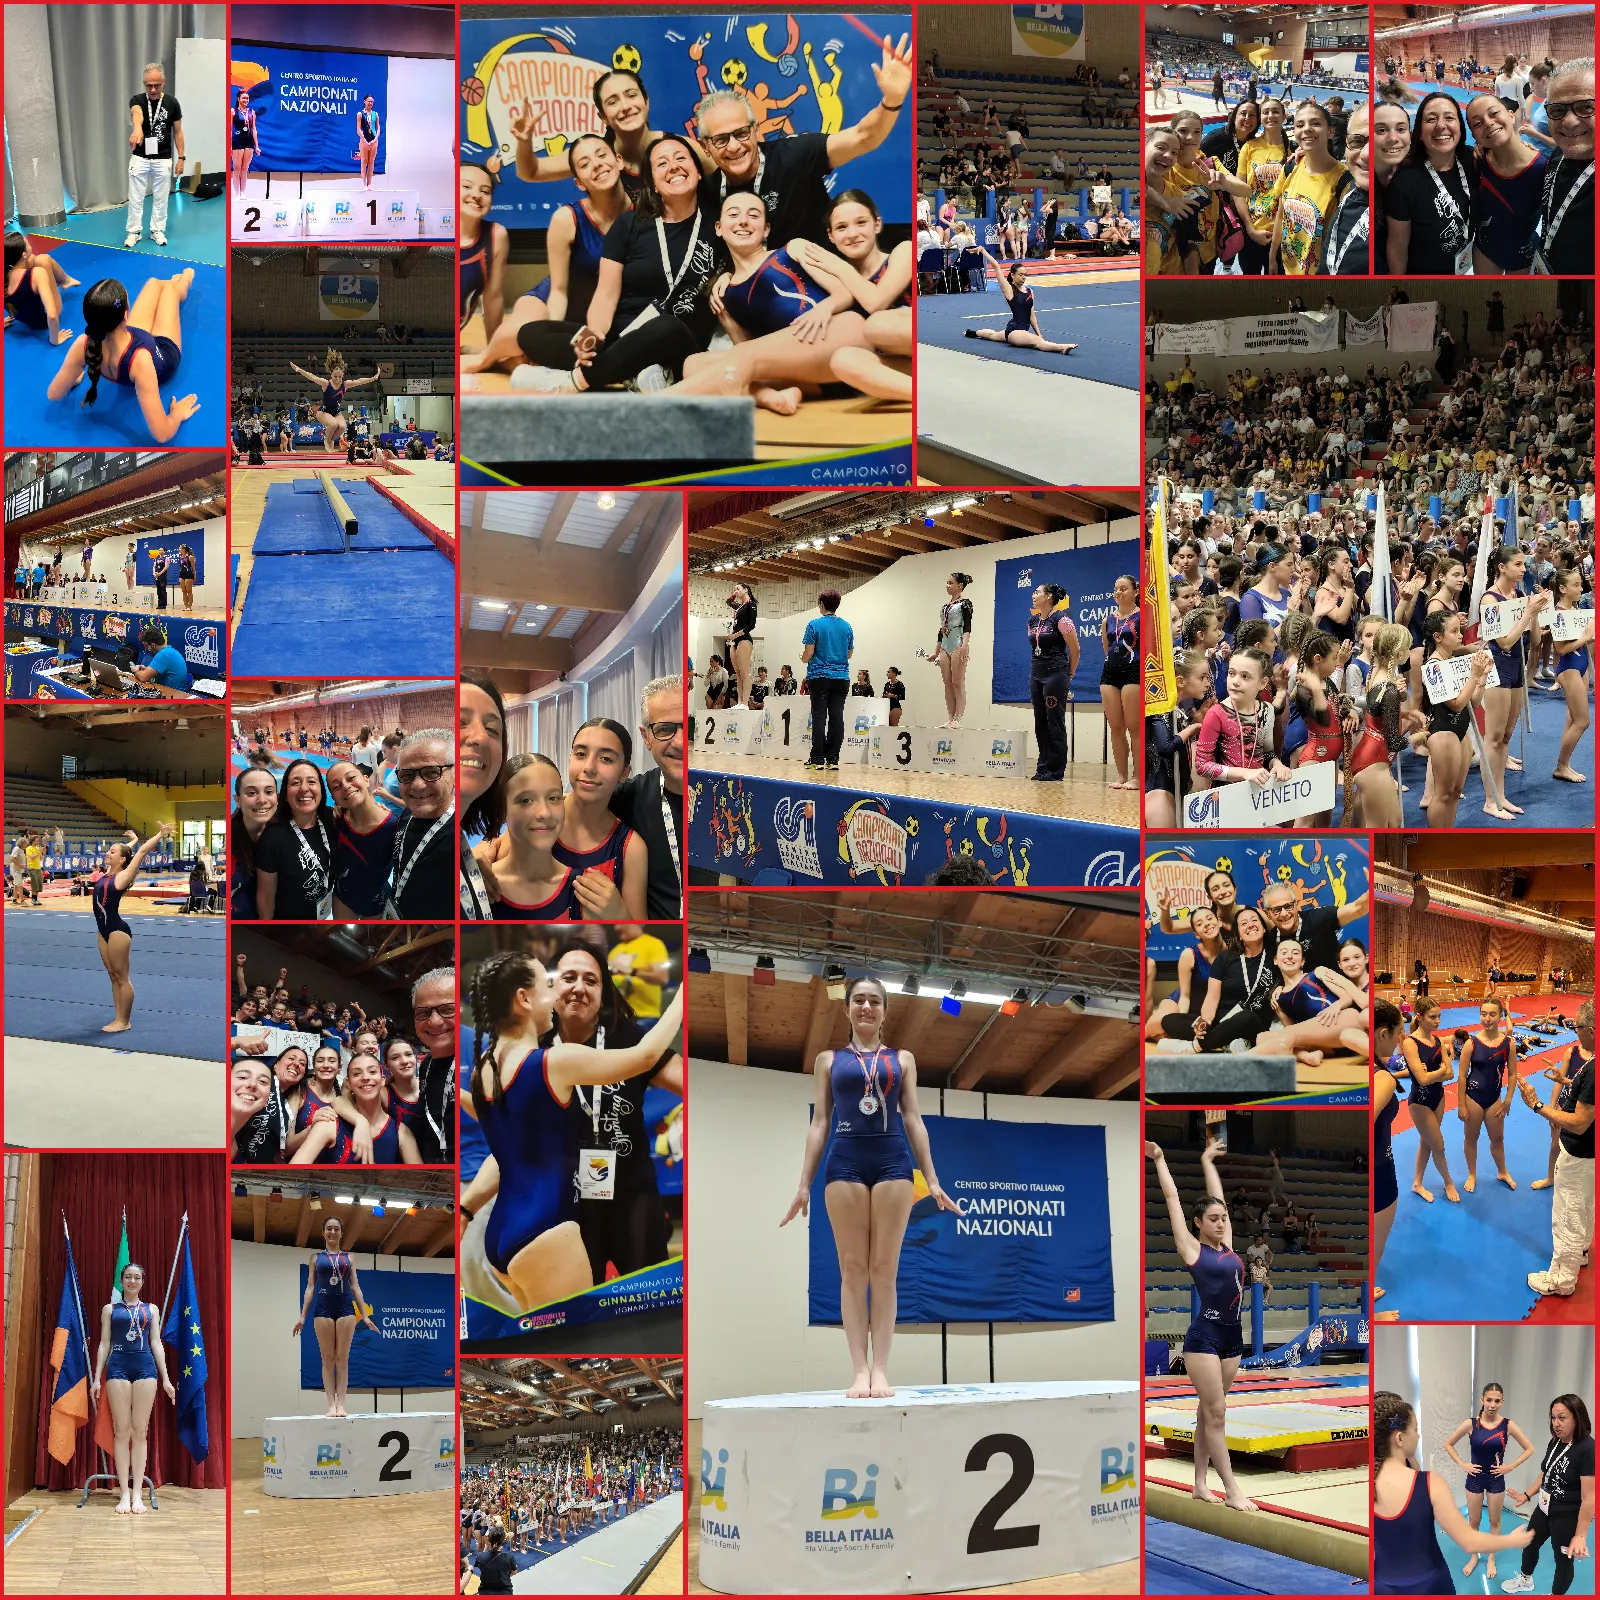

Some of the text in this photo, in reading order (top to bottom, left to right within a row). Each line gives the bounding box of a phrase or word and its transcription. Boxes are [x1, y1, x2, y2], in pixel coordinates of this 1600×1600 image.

[1026, 22, 1071, 34] BELLA ITALIA
[281, 84, 358, 101] CAMPIONATI
[281, 100, 347, 115] NAZIONALI
[244, 207, 261, 232] 2
[366, 200, 377, 226] 1
[811, 463, 907, 479] CAMPIONATO
[705, 717, 715, 744] 2
[782, 709, 791, 746] 1
[896, 732, 911, 765] 3
[1252, 779, 1312, 811] VENETO
[853, 812, 904, 851] CAMPIONATI
[856, 840, 902, 870] NAZIONALI
[600, 1094, 635, 1157] Sporting
[955, 1180, 1065, 1192] CENTRO SPORTIVO ITALIANO
[956, 1197, 1065, 1217] CAMPIONATI
[957, 1219, 1052, 1237] NAZIONALI
[612, 1277, 673, 1293] CAMPIONATO
[599, 1289, 667, 1307] GINNASTICA
[382, 1316, 446, 1328] CAMPIONATI
[382, 1329, 438, 1339] NAZIONALI
[378, 1430, 412, 1482] 2
[964, 1433, 1040, 1554] 2
[1090, 1501, 1119, 1517] BELLA
[706, 1519, 741, 1540] ITALIA
[805, 1527, 894, 1543] BELLA ITALIA
[720, 1540, 741, 1552] Family
[871, 1542, 895, 1551] Family
